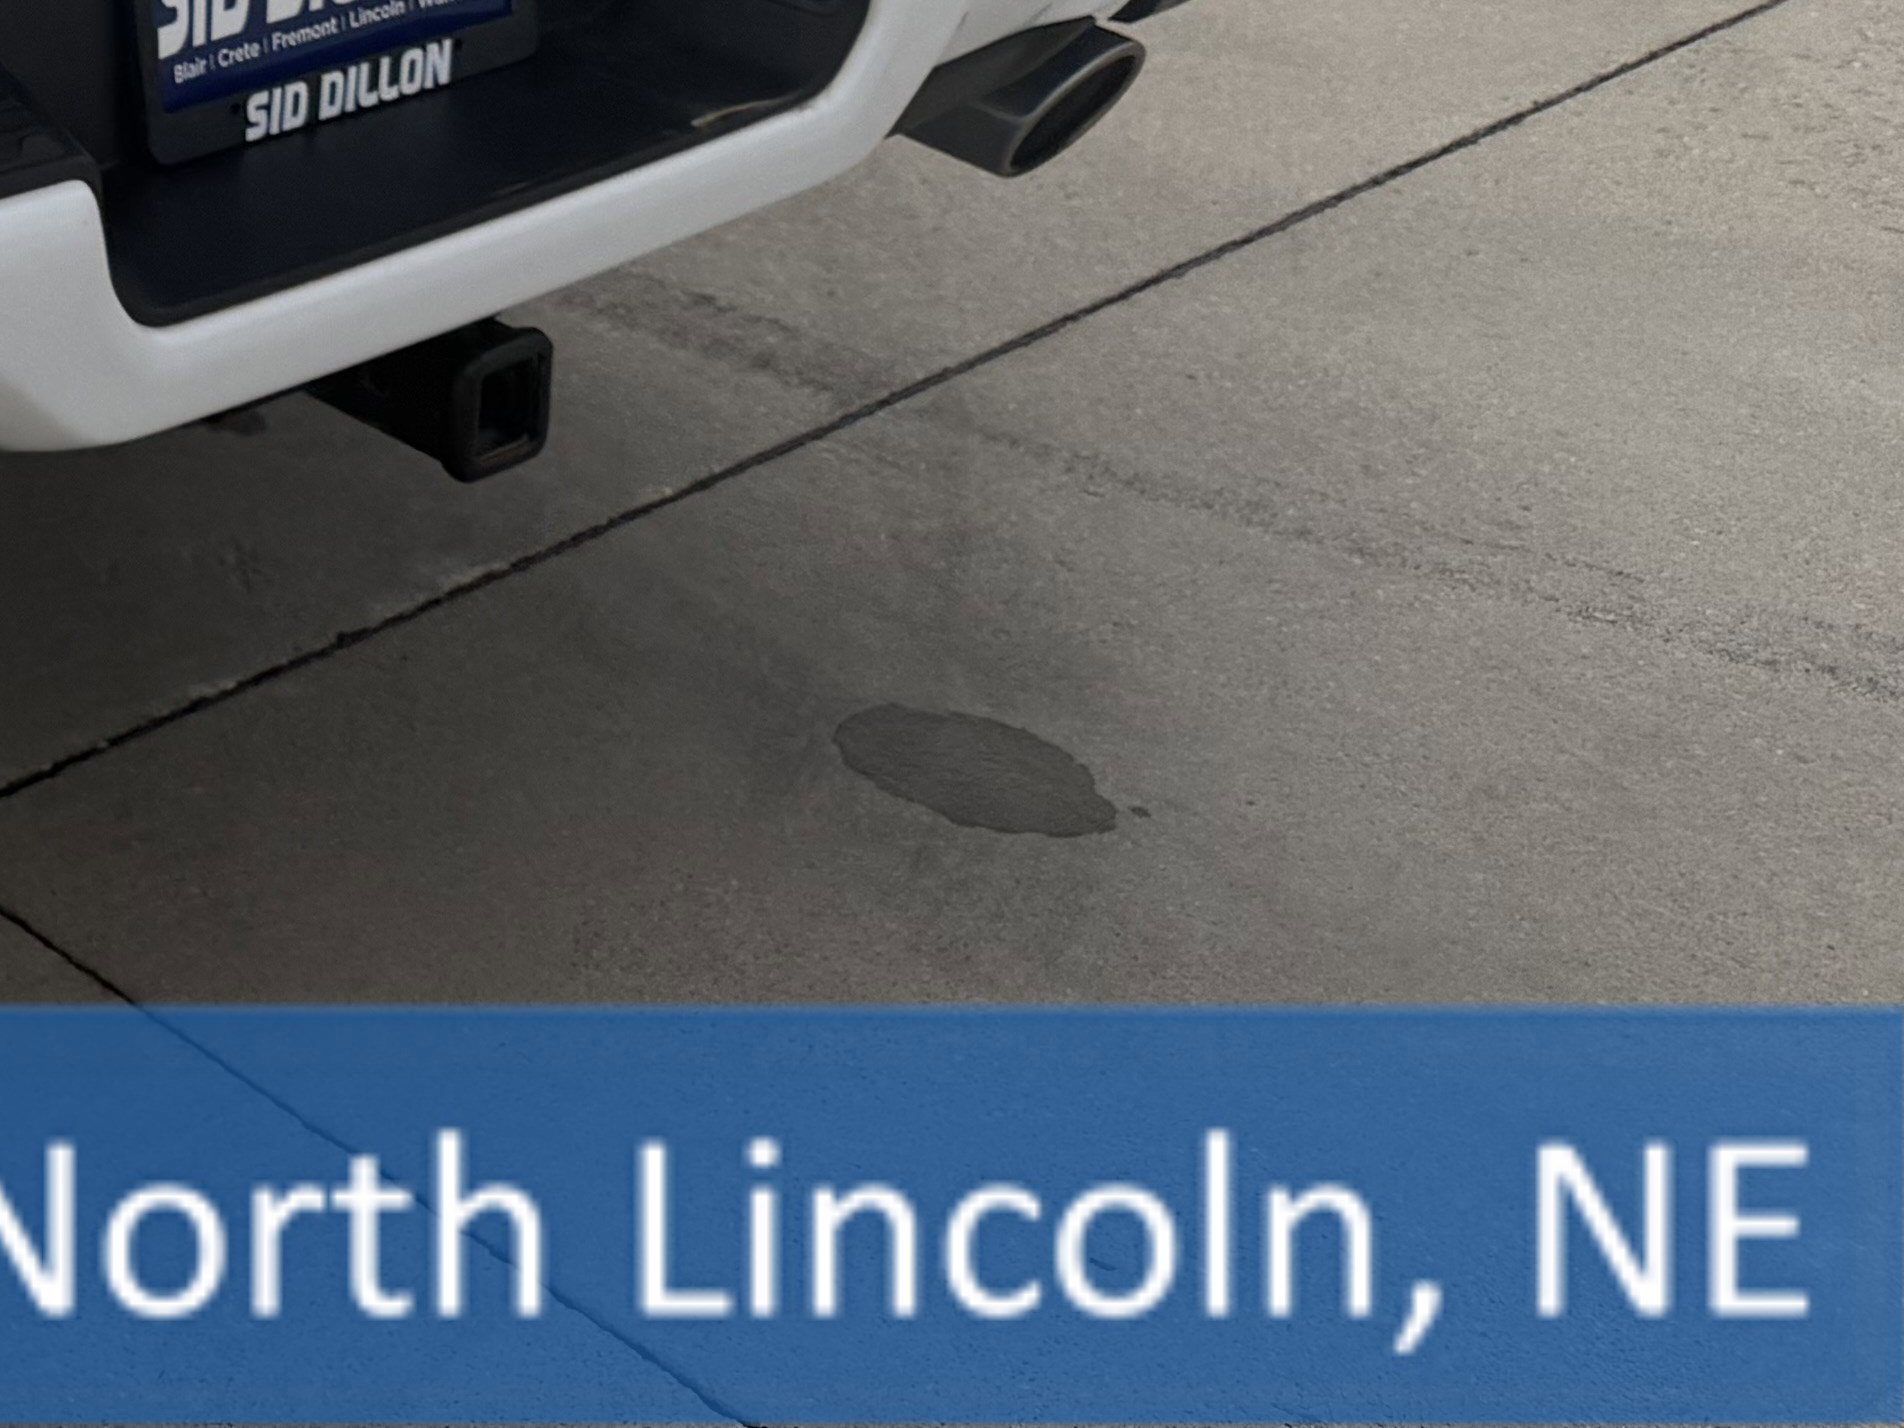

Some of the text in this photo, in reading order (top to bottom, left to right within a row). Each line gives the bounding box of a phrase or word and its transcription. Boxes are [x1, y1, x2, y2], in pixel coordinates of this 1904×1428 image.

[173, 56, 207, 83] Blair
[217, 41, 261, 68] Crete
[271, 19, 341, 51] Fremont
[348, 0, 406, 29] Lincoln
[245, 38, 455, 143] SID DILLON
